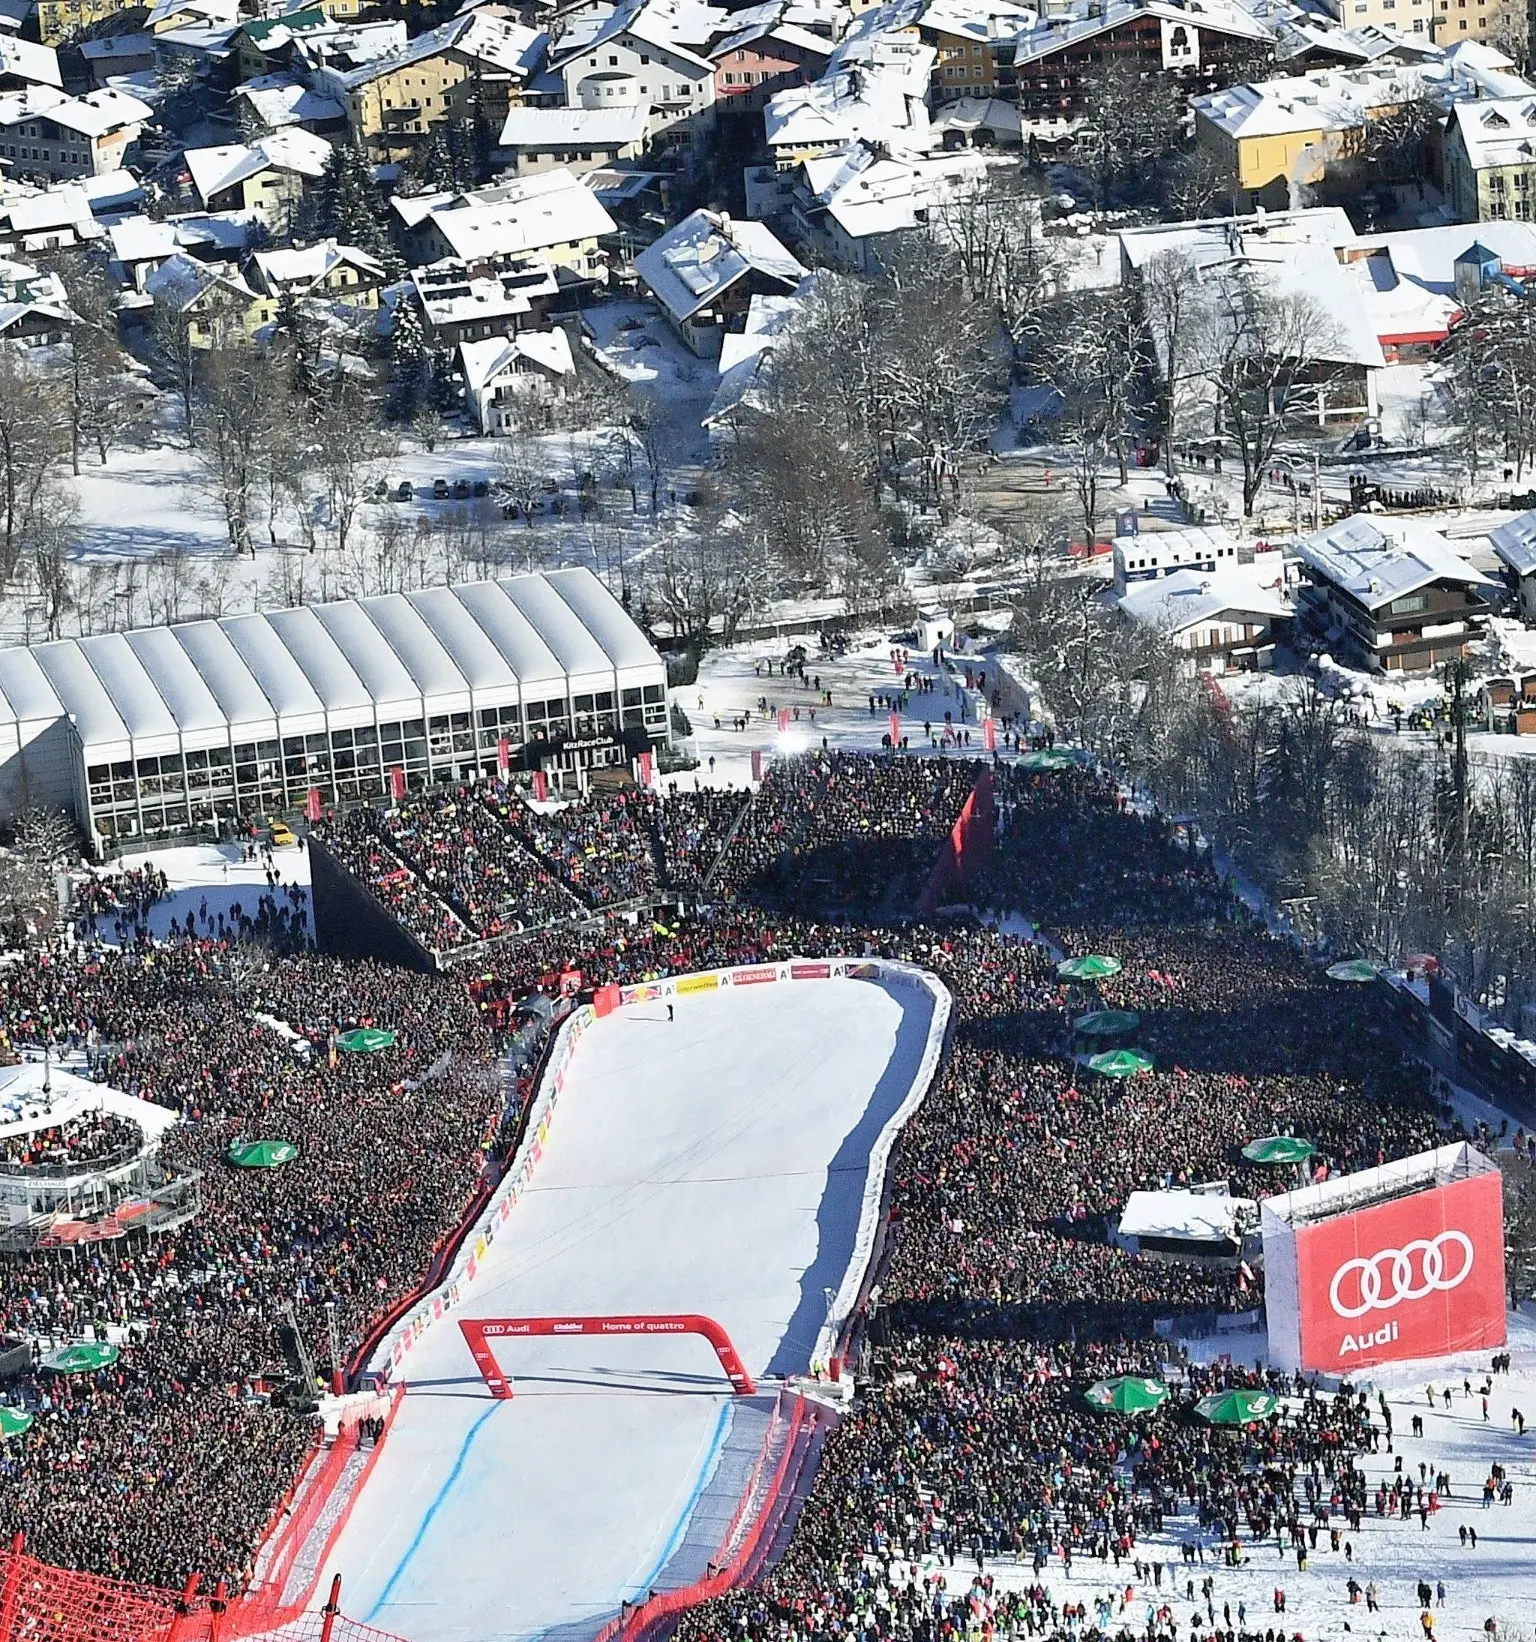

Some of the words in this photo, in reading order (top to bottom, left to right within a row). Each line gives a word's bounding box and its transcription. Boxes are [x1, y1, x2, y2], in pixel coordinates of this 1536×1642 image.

[507, 1324, 530, 1333] Audi
[602, 1322, 631, 1331] Home
[634, 1321, 645, 1330] of
[646, 1321, 685, 1331] quattro
[1339, 1320, 1399, 1356] Audi
